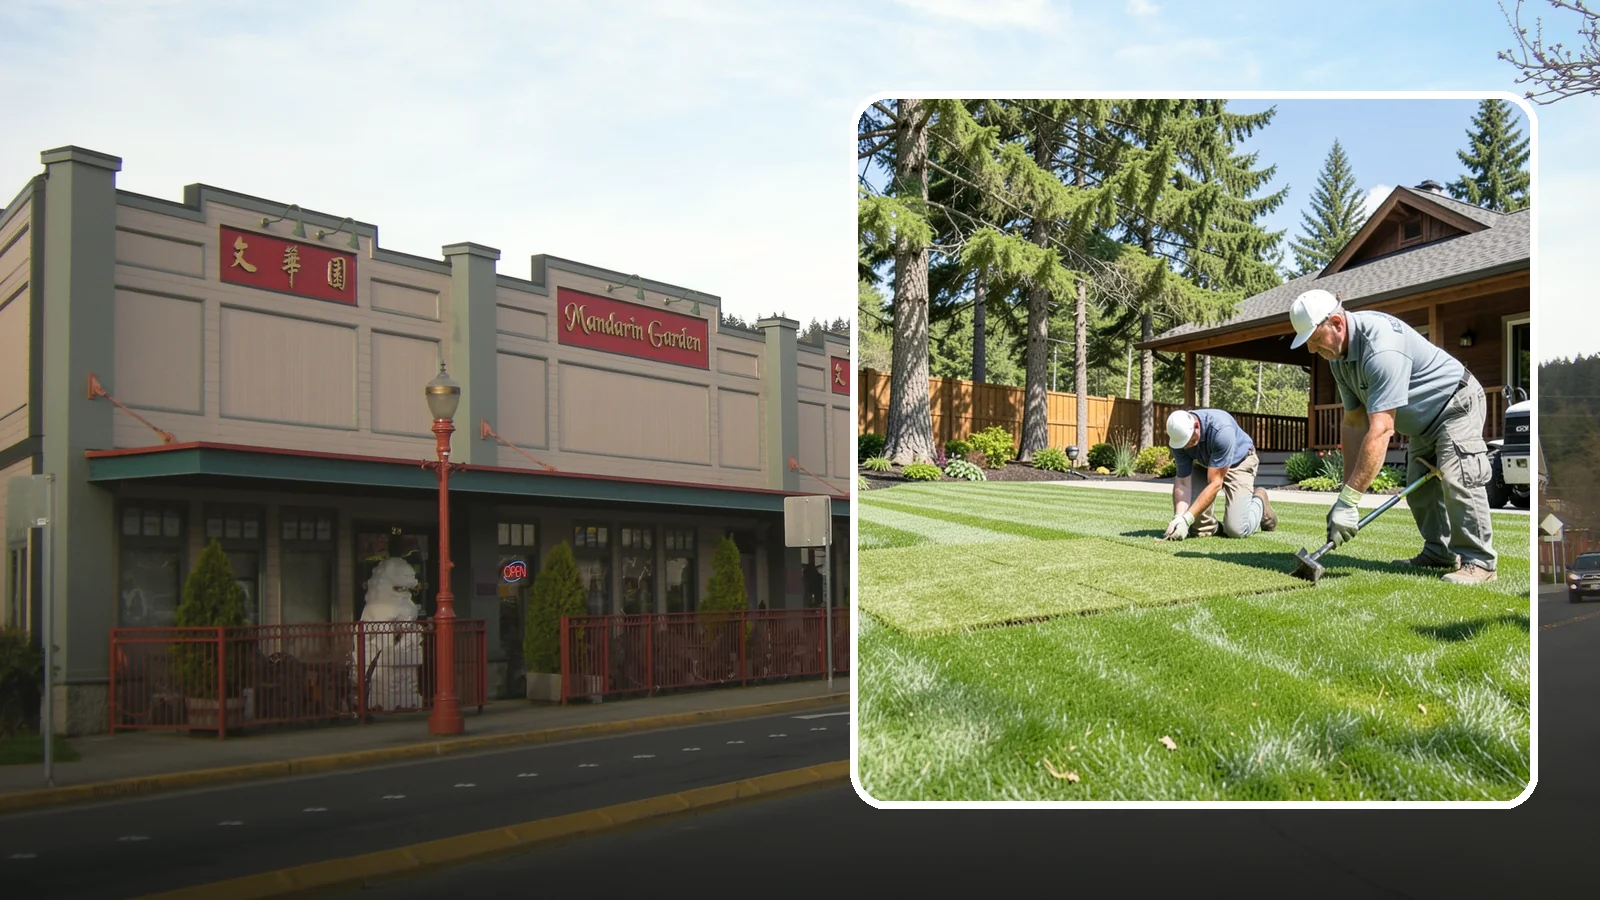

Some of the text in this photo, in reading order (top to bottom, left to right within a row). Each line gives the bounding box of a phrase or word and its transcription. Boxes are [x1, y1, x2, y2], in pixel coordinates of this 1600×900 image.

[231, 235, 346, 291] 文華園
[564, 302, 702, 352] Mandarin Garden
[503, 565, 527, 578] OPEN
